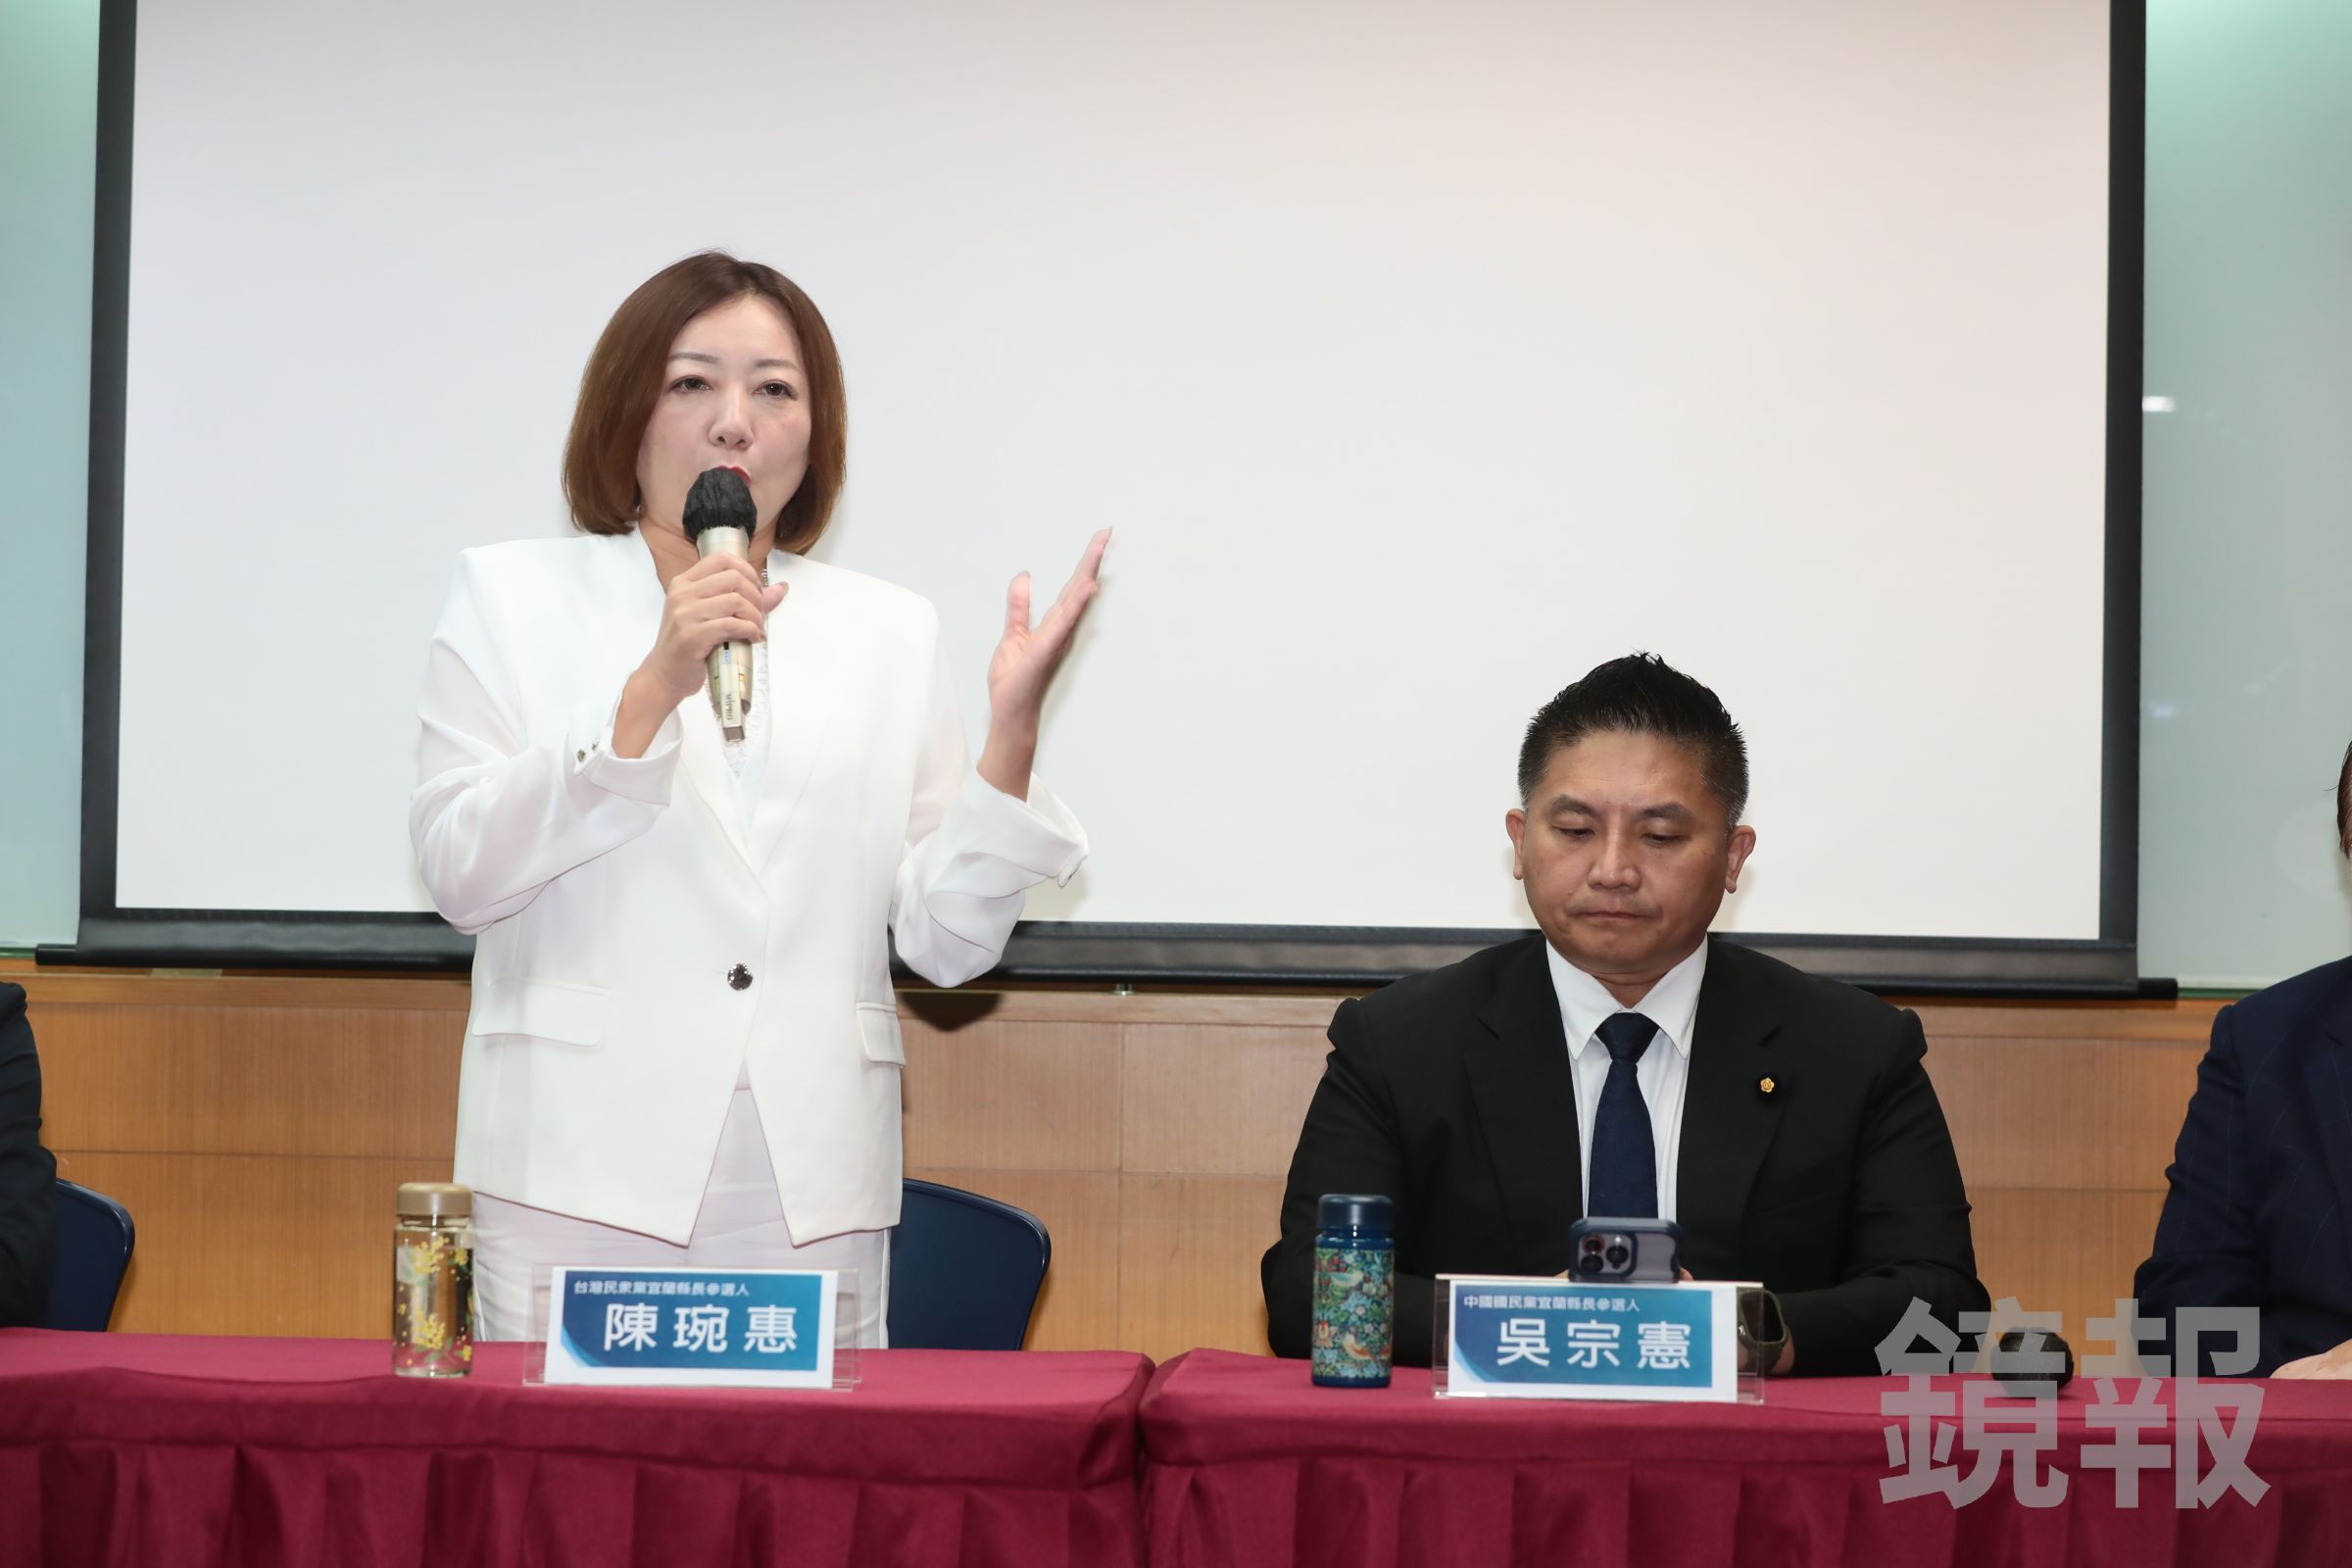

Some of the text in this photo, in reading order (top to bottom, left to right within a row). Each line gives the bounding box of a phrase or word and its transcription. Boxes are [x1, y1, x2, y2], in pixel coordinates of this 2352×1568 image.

[604, 1302, 797, 1353] 陳琬惠
[1497, 1318, 1690, 1369] 吳宗憲
